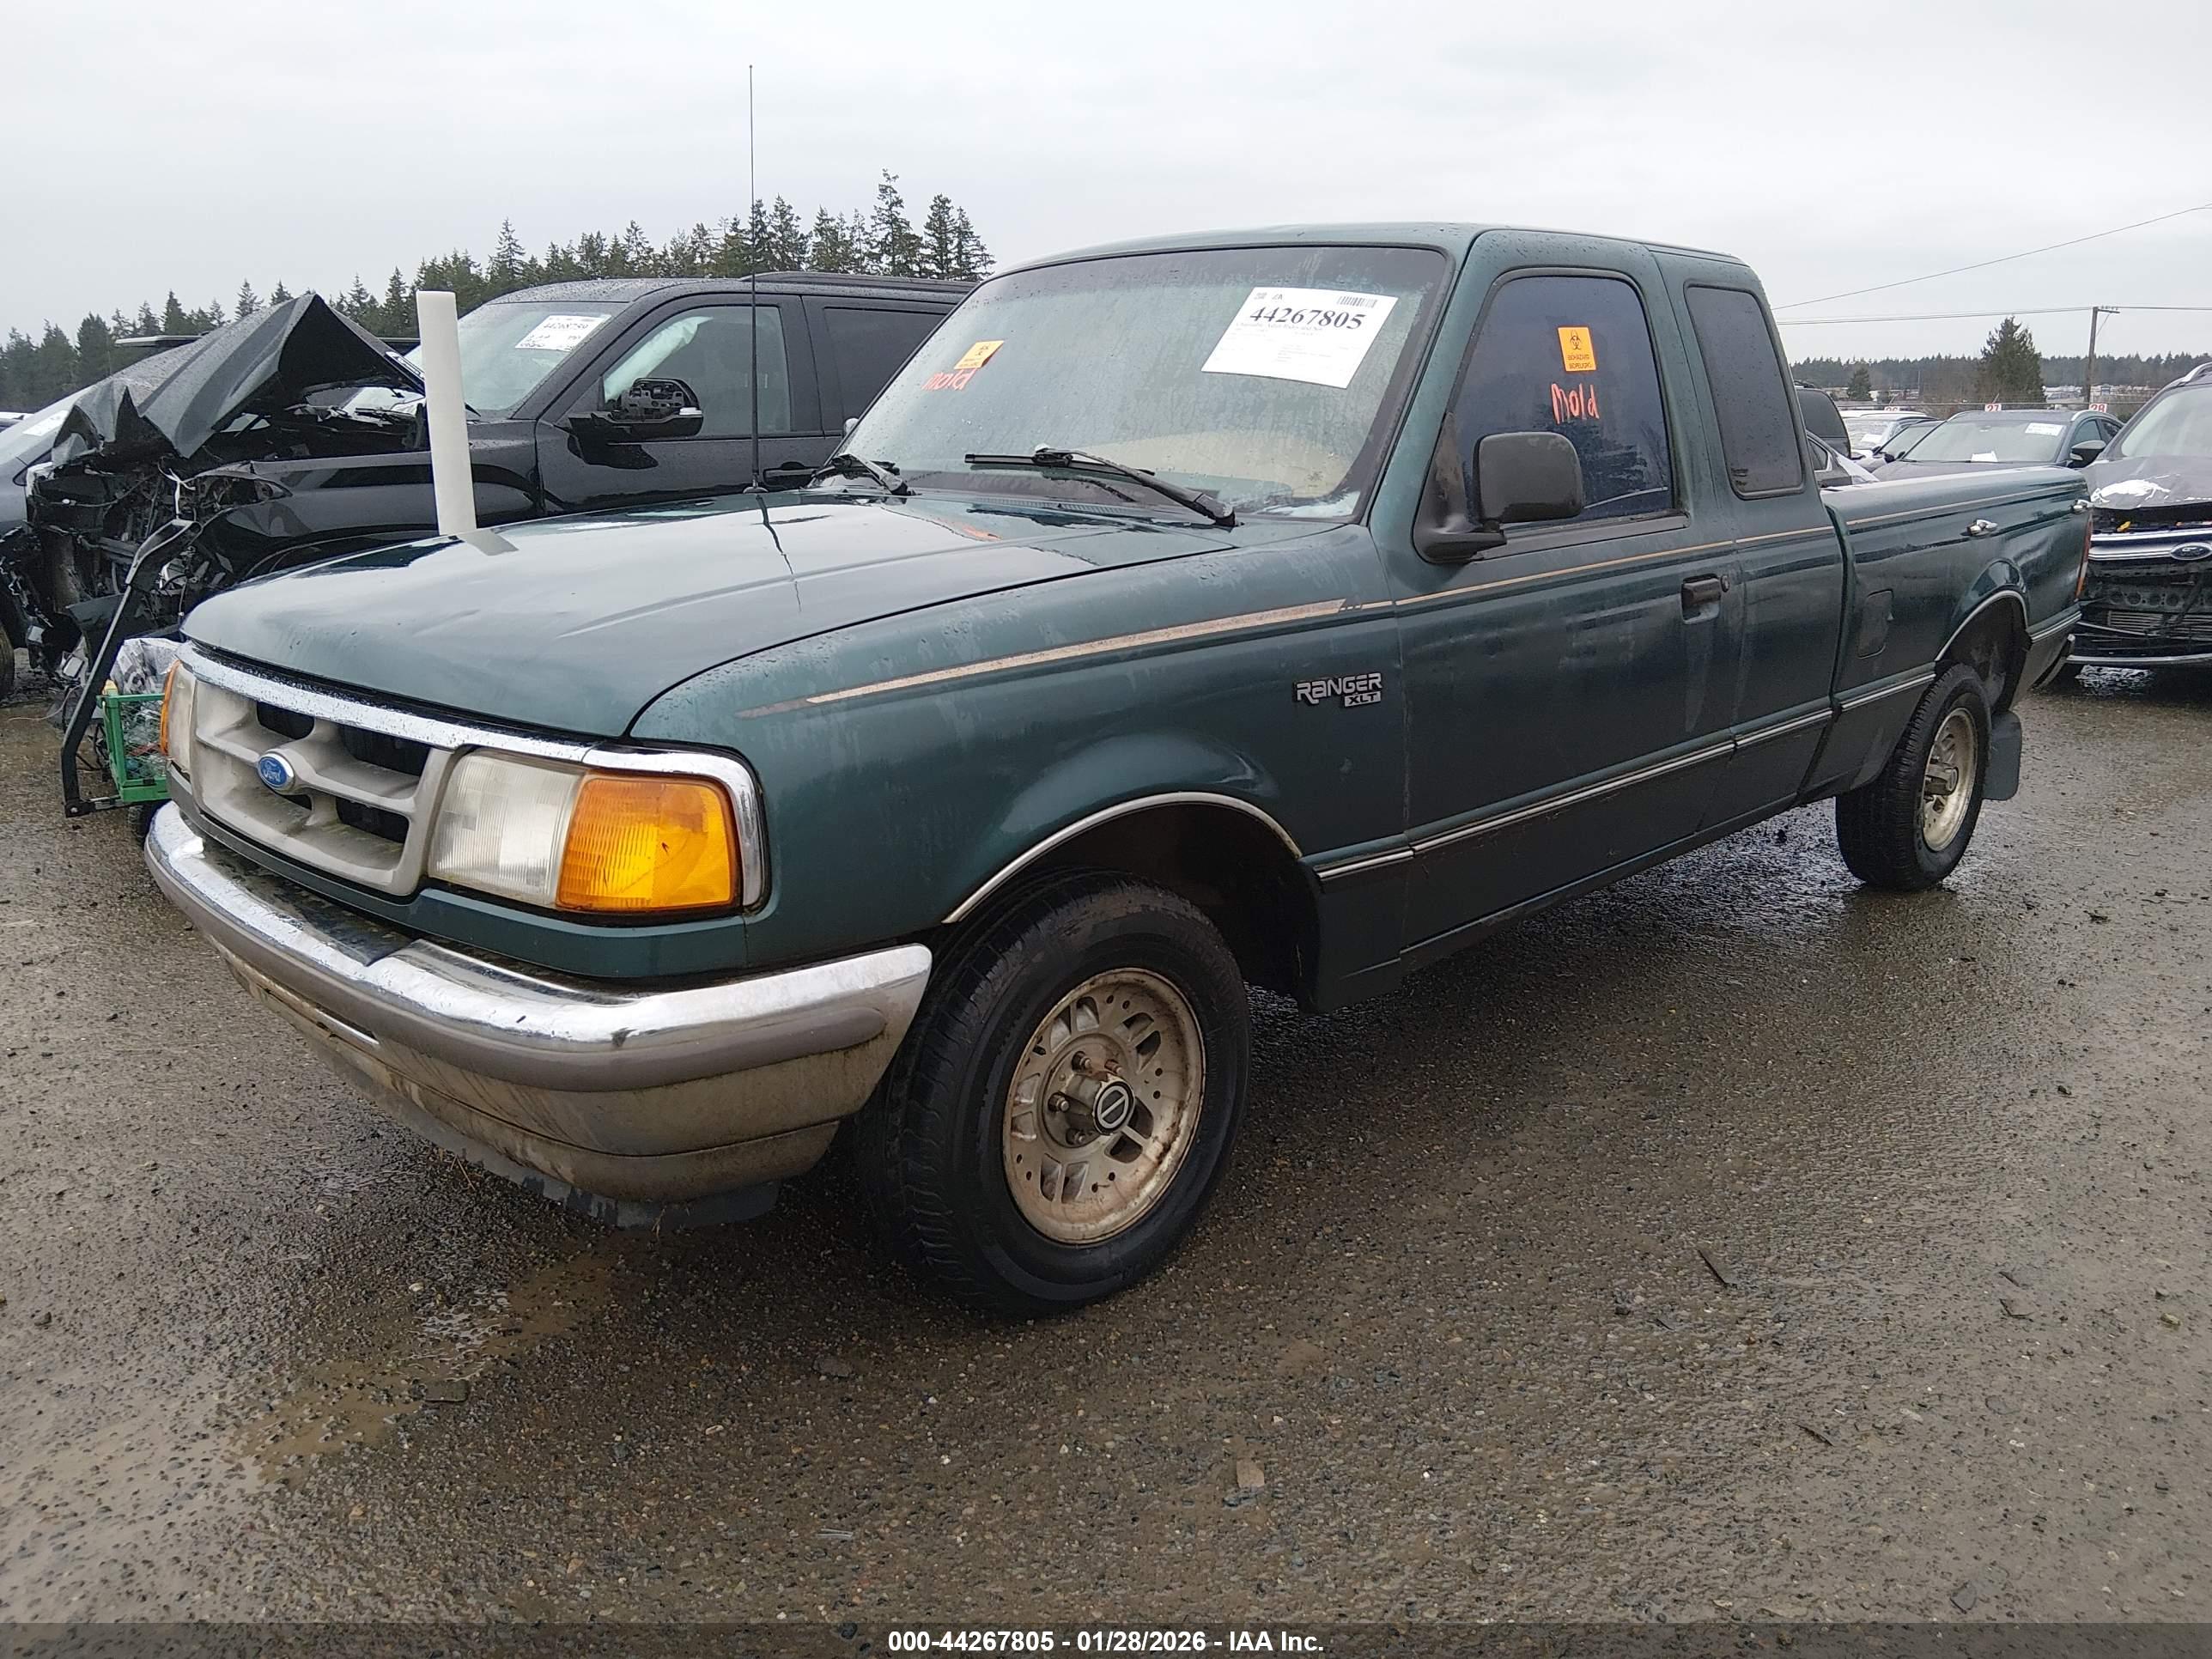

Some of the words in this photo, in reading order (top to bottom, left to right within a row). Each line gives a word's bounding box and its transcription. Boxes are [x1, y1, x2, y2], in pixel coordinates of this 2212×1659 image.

[1249, 307, 1367, 330] 44267805
[1297, 672, 1382, 705] RANGER
[1349, 693, 1378, 705] XLT
